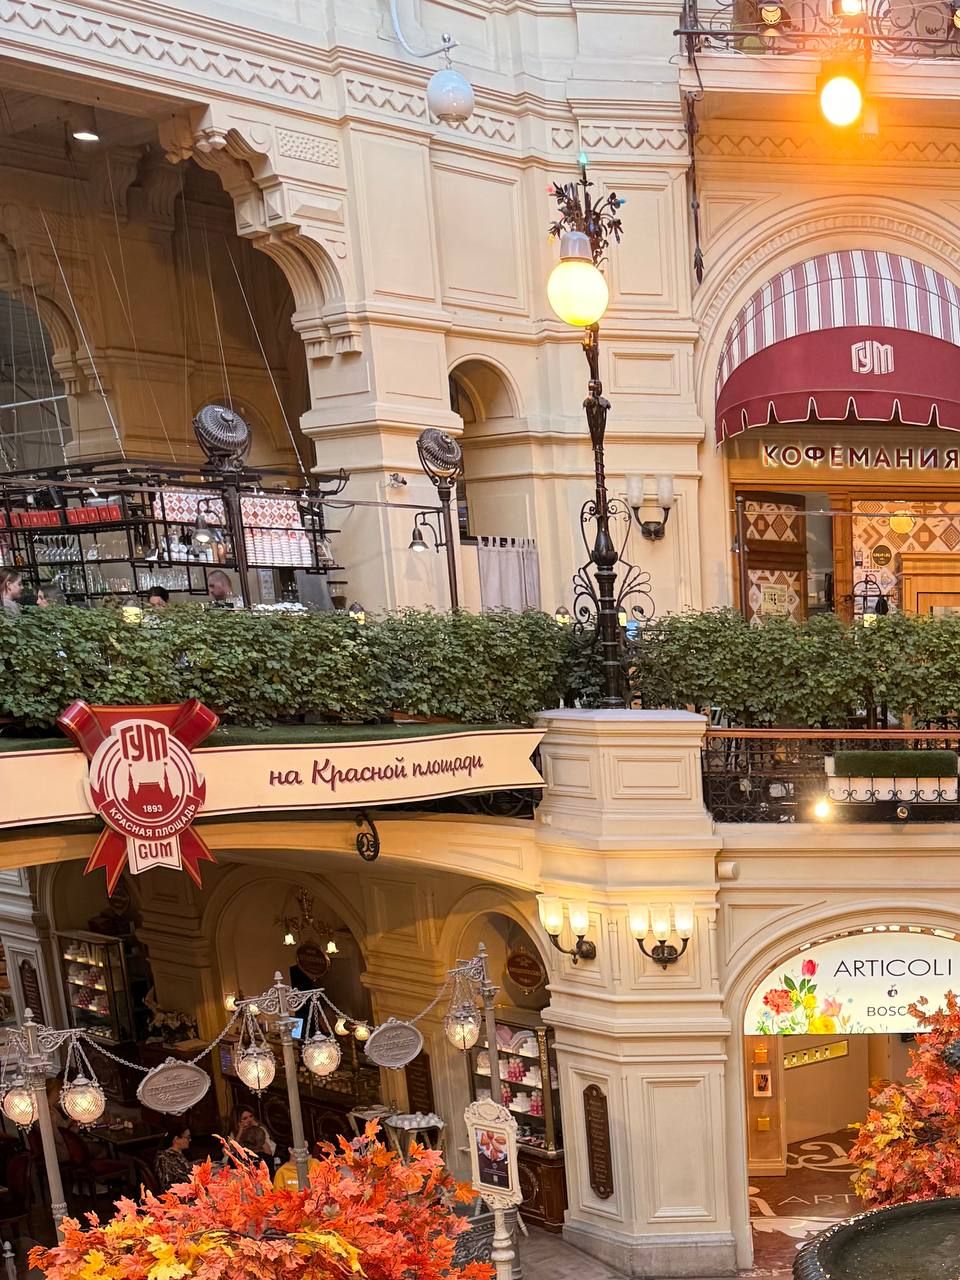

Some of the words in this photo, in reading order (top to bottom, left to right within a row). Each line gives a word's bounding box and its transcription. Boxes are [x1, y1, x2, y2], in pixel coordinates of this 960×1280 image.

[851, 340, 895, 375] ГУМ
[763, 444, 960, 470] КОФЕМАНИЯ
[120, 724, 168, 762] ГУМ
[269, 770, 303, 786] на
[311, 757, 408, 792] Красной
[412, 754, 484, 778] площади
[109, 807, 153, 837] КРАСНАЯ
[155, 804, 196, 837] ПЛОЩАДЬ
[142, 804, 163, 813] 1893
[137, 842, 173, 860] GUM
[833, 958, 952, 977] ARTICOLI
[866, 1006, 908, 1017] BOSC
